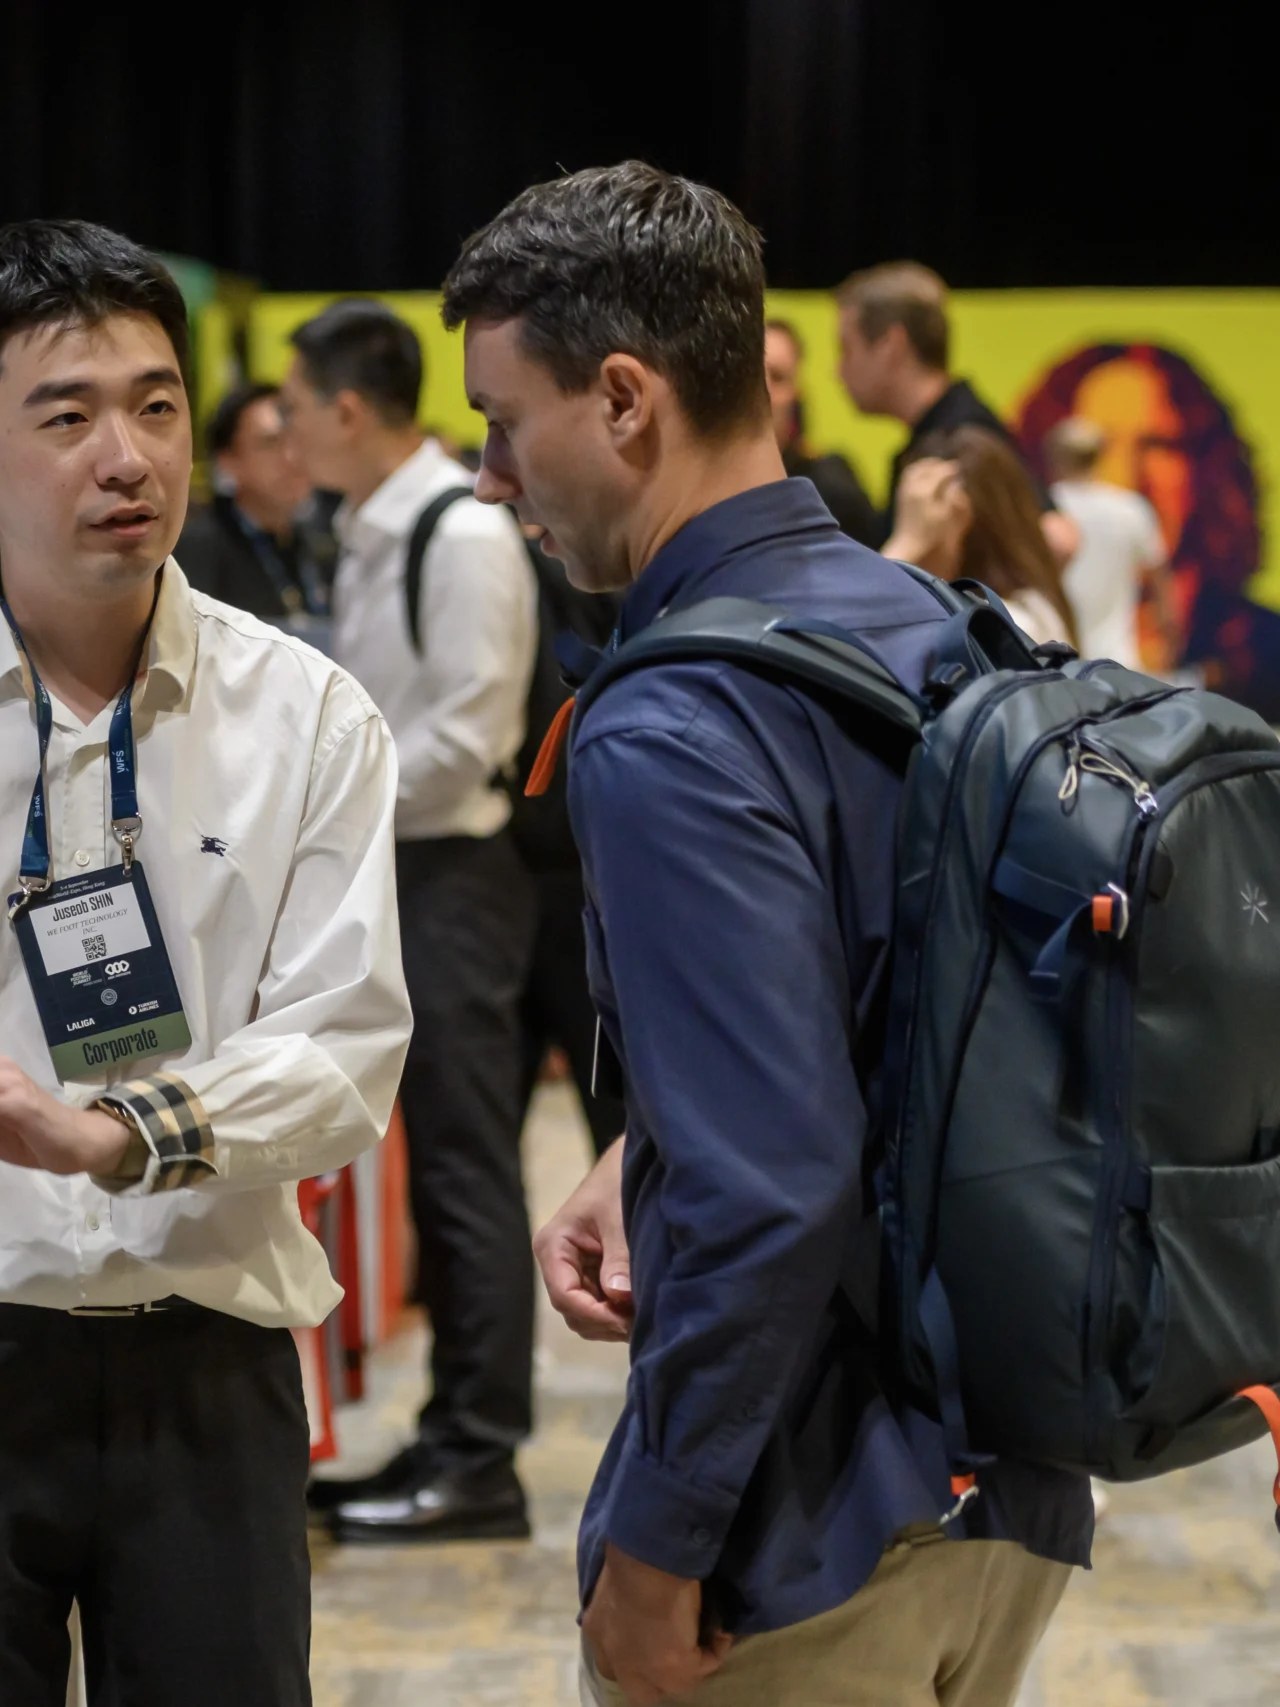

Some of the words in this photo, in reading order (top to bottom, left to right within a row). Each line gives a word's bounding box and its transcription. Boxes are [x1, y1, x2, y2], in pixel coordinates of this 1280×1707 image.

[114, 750, 126, 773] WFS
[53, 900, 89, 922] Juseob
[89, 892, 115, 910] SHIN
[47, 929, 59, 937] WE
[60, 922, 80, 933] FOOT
[80, 908, 129, 928] TECHNOLOGY
[66, 1018, 95, 1031] LALIGA
[82, 1028, 159, 1066] Corporate
